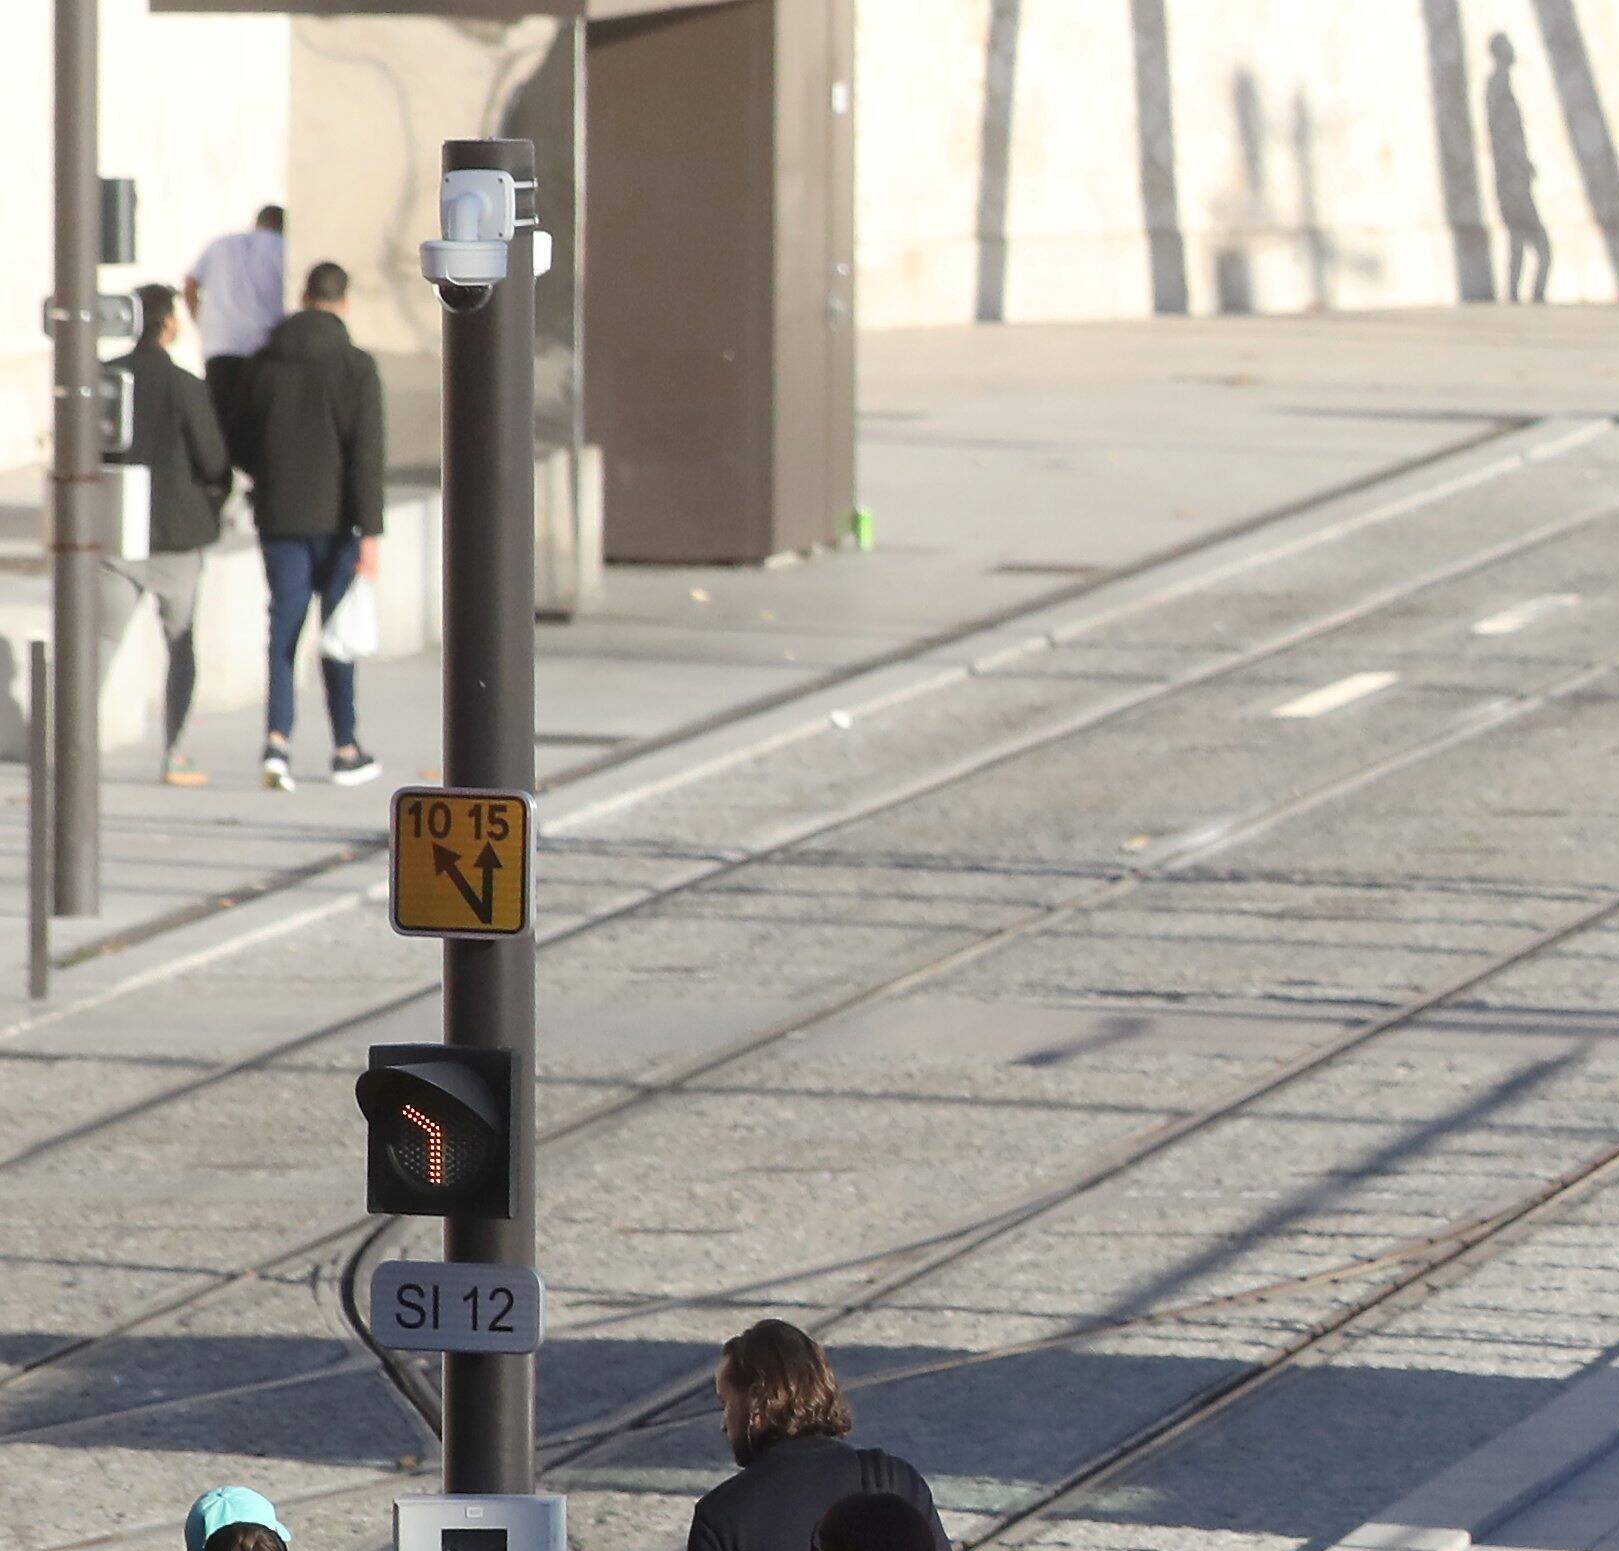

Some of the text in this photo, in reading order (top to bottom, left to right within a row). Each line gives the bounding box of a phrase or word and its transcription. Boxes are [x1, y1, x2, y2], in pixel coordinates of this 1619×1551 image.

[408, 801, 510, 842] 10 15
[395, 1283, 515, 1332] SI 12
